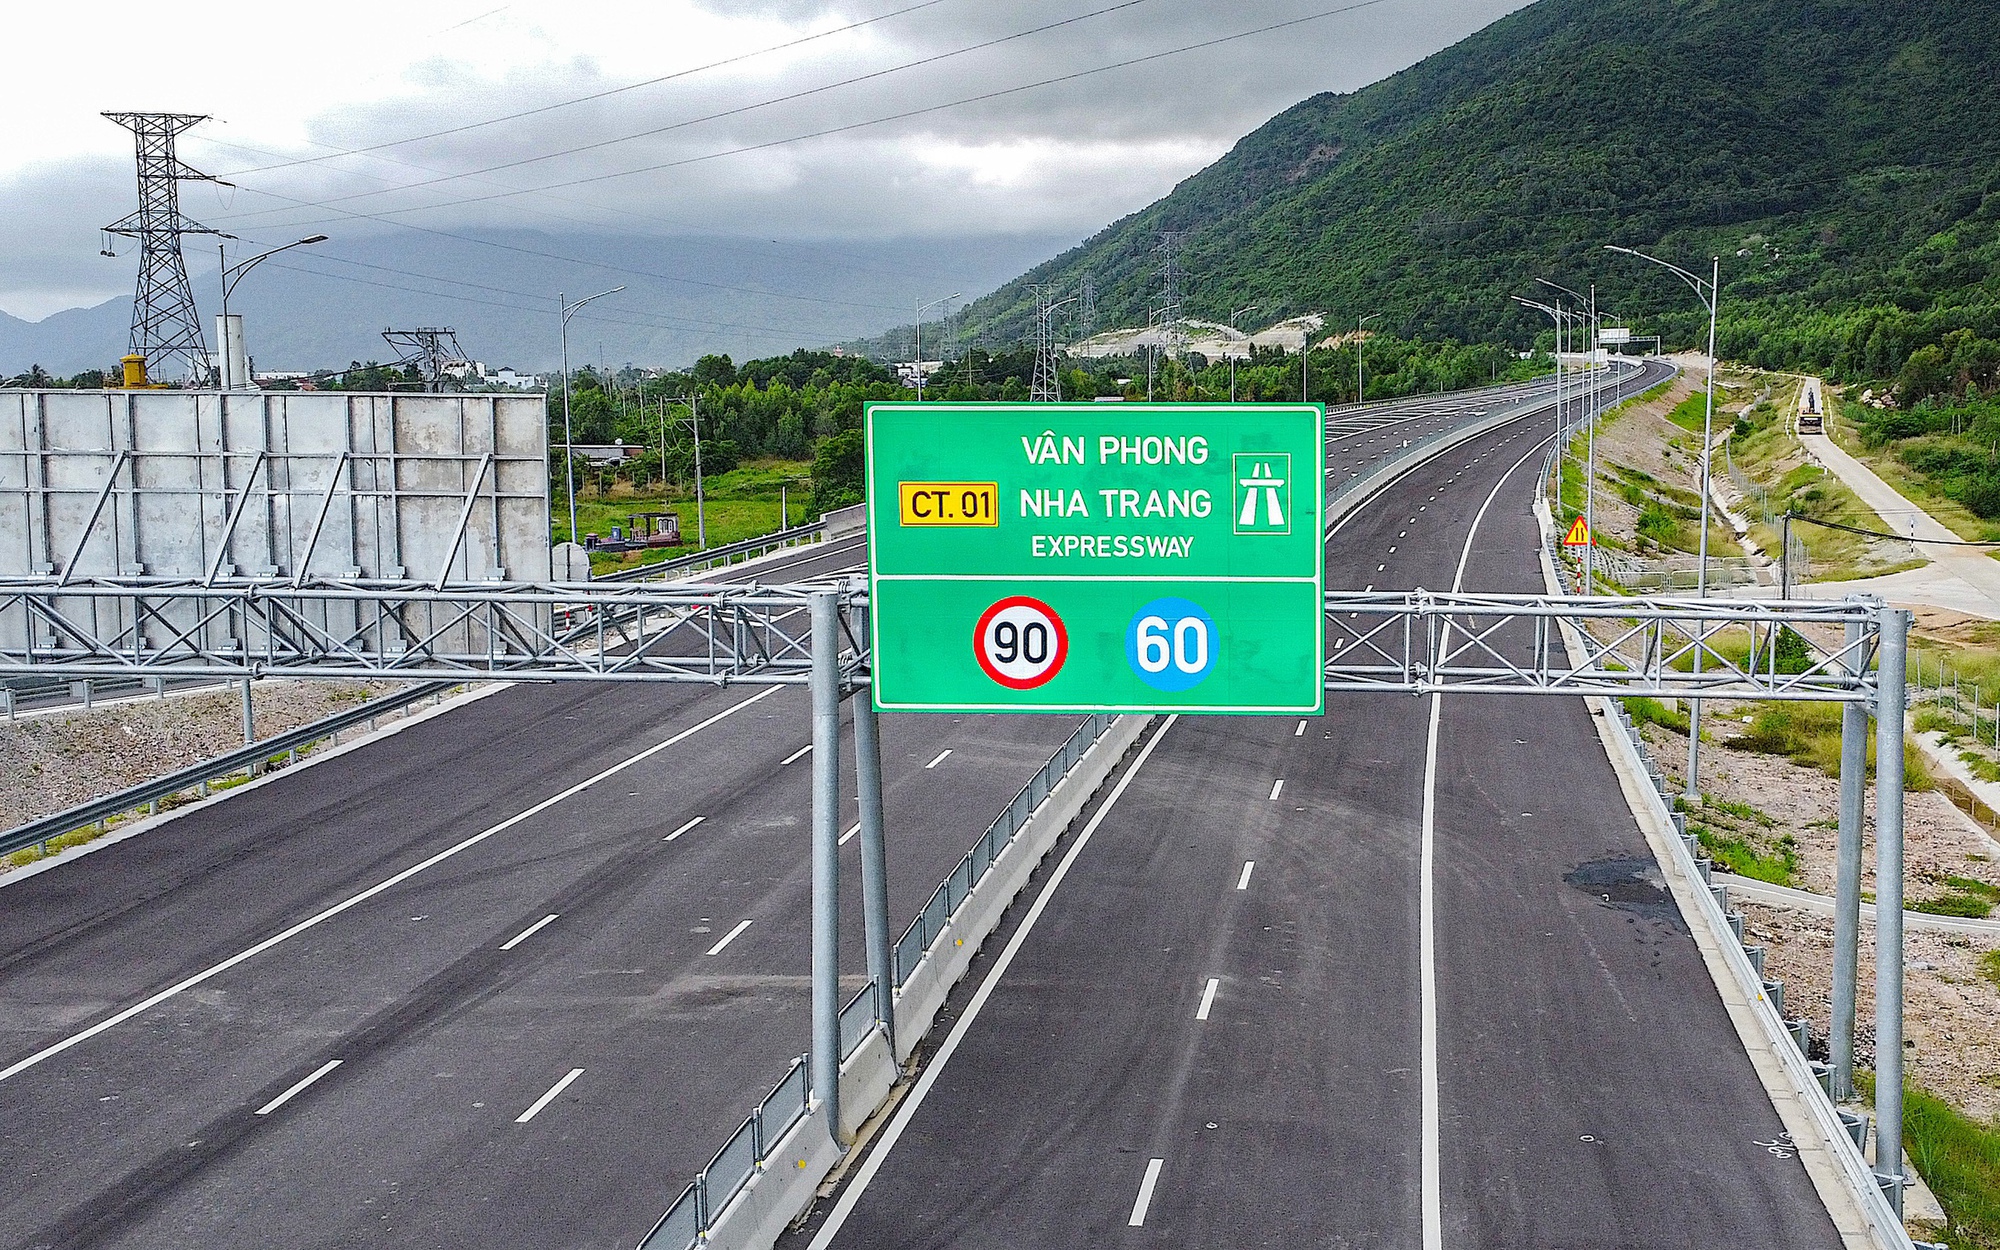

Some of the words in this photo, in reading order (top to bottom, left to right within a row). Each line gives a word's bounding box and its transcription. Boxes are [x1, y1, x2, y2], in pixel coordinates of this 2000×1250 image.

[1021, 430, 1085, 465] VÂN
[1099, 436, 1209, 465] PHONG
[912, 490, 954, 519] CT.
[961, 490, 990, 519] 01
[1020, 489, 1089, 518] NHA
[1098, 489, 1212, 518] TRANG
[1031, 535, 1195, 558] EXPRESSWAY
[994, 621, 1048, 664] 90
[1136, 615, 1208, 674] 60
